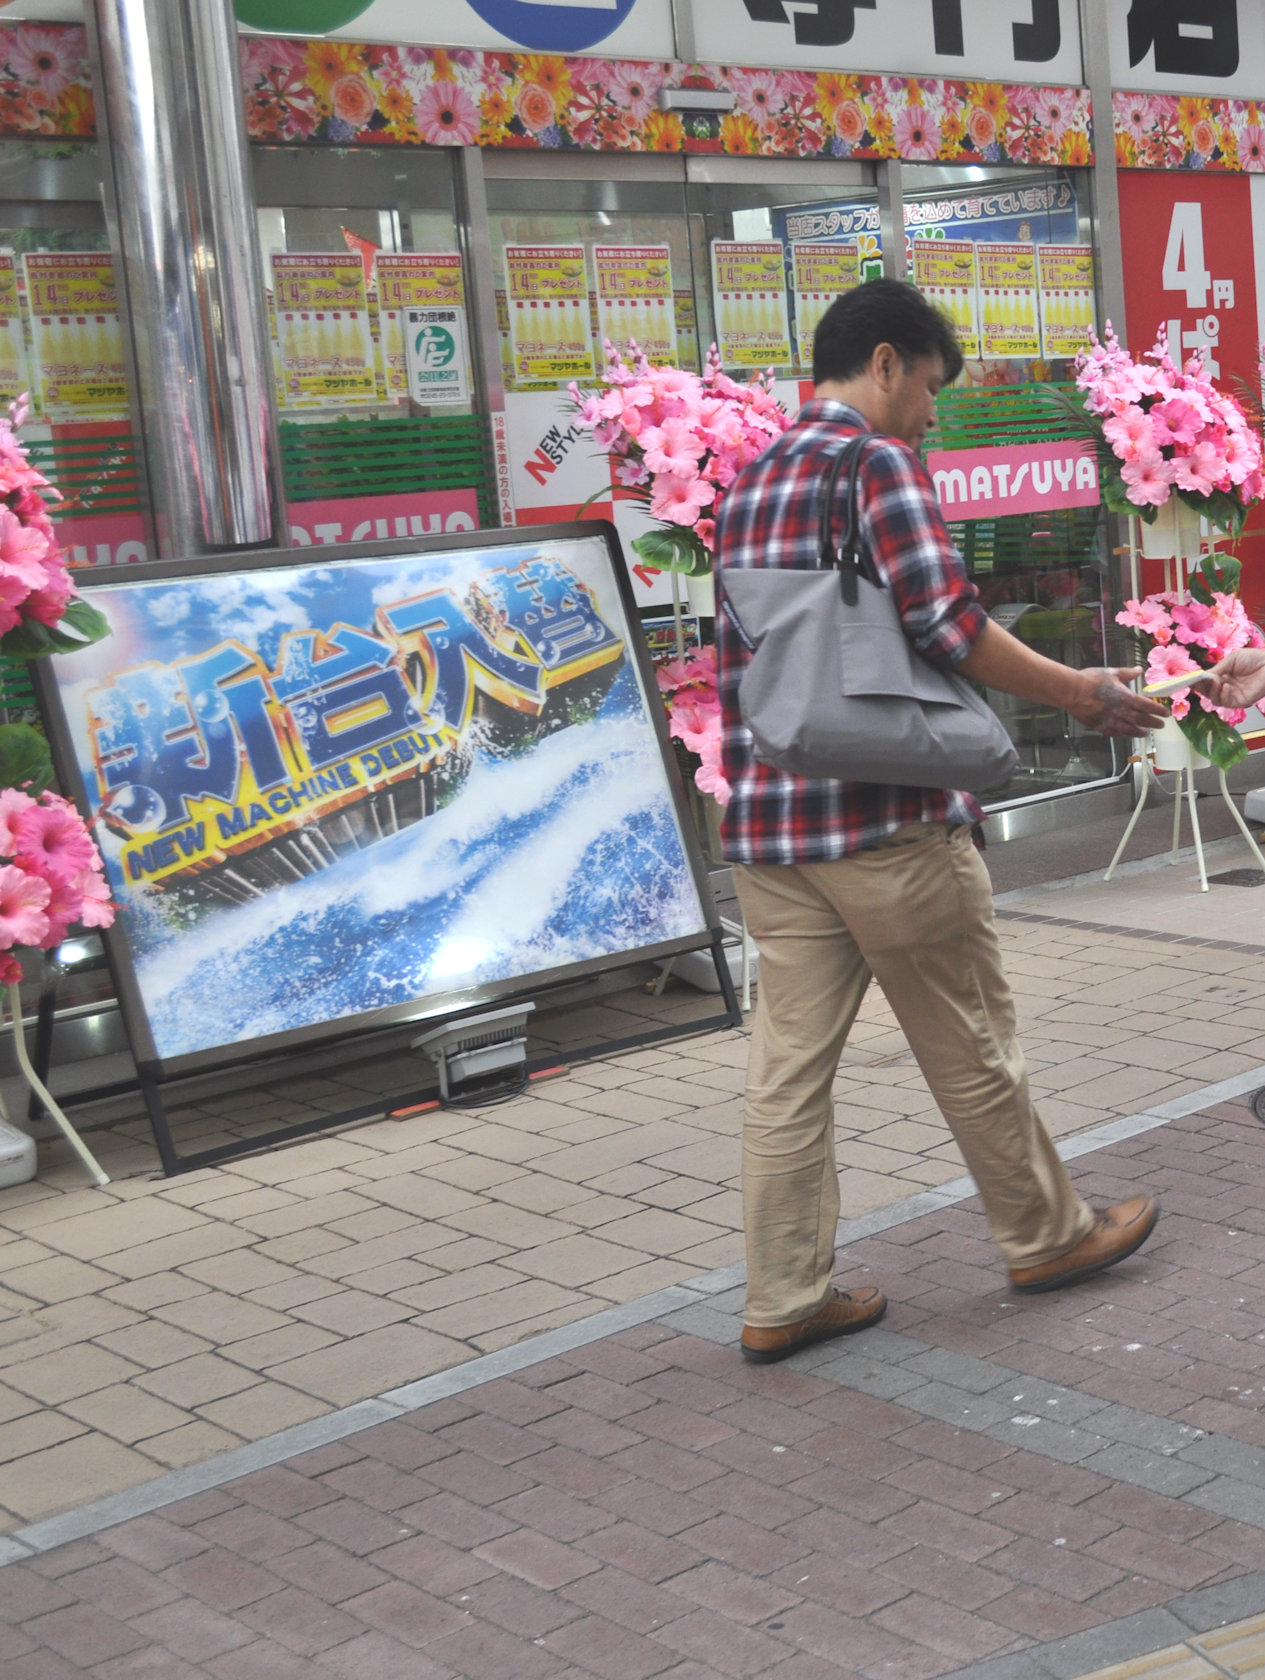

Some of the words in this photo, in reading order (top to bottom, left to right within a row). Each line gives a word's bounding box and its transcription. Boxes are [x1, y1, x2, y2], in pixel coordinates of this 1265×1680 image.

[786, 206, 880, 238] 当店スタッフが
[541, 279, 584, 289] プレゼント
[314, 288, 362, 300] プレゼント
[415, 288, 461, 299] プレゼント
[409, 311, 457, 323] 暴力団根絶
[550, 362, 591, 371] マツヤホール
[324, 378, 373, 389] マツヤホール
[493, 416, 514, 528] 18歳未満の方の入場
[932, 456, 1097, 504] MATSUYA
[127, 822, 206, 880] NEW
[215, 763, 360, 840] MACHINE
[359, 732, 444, 777] DEBUT
